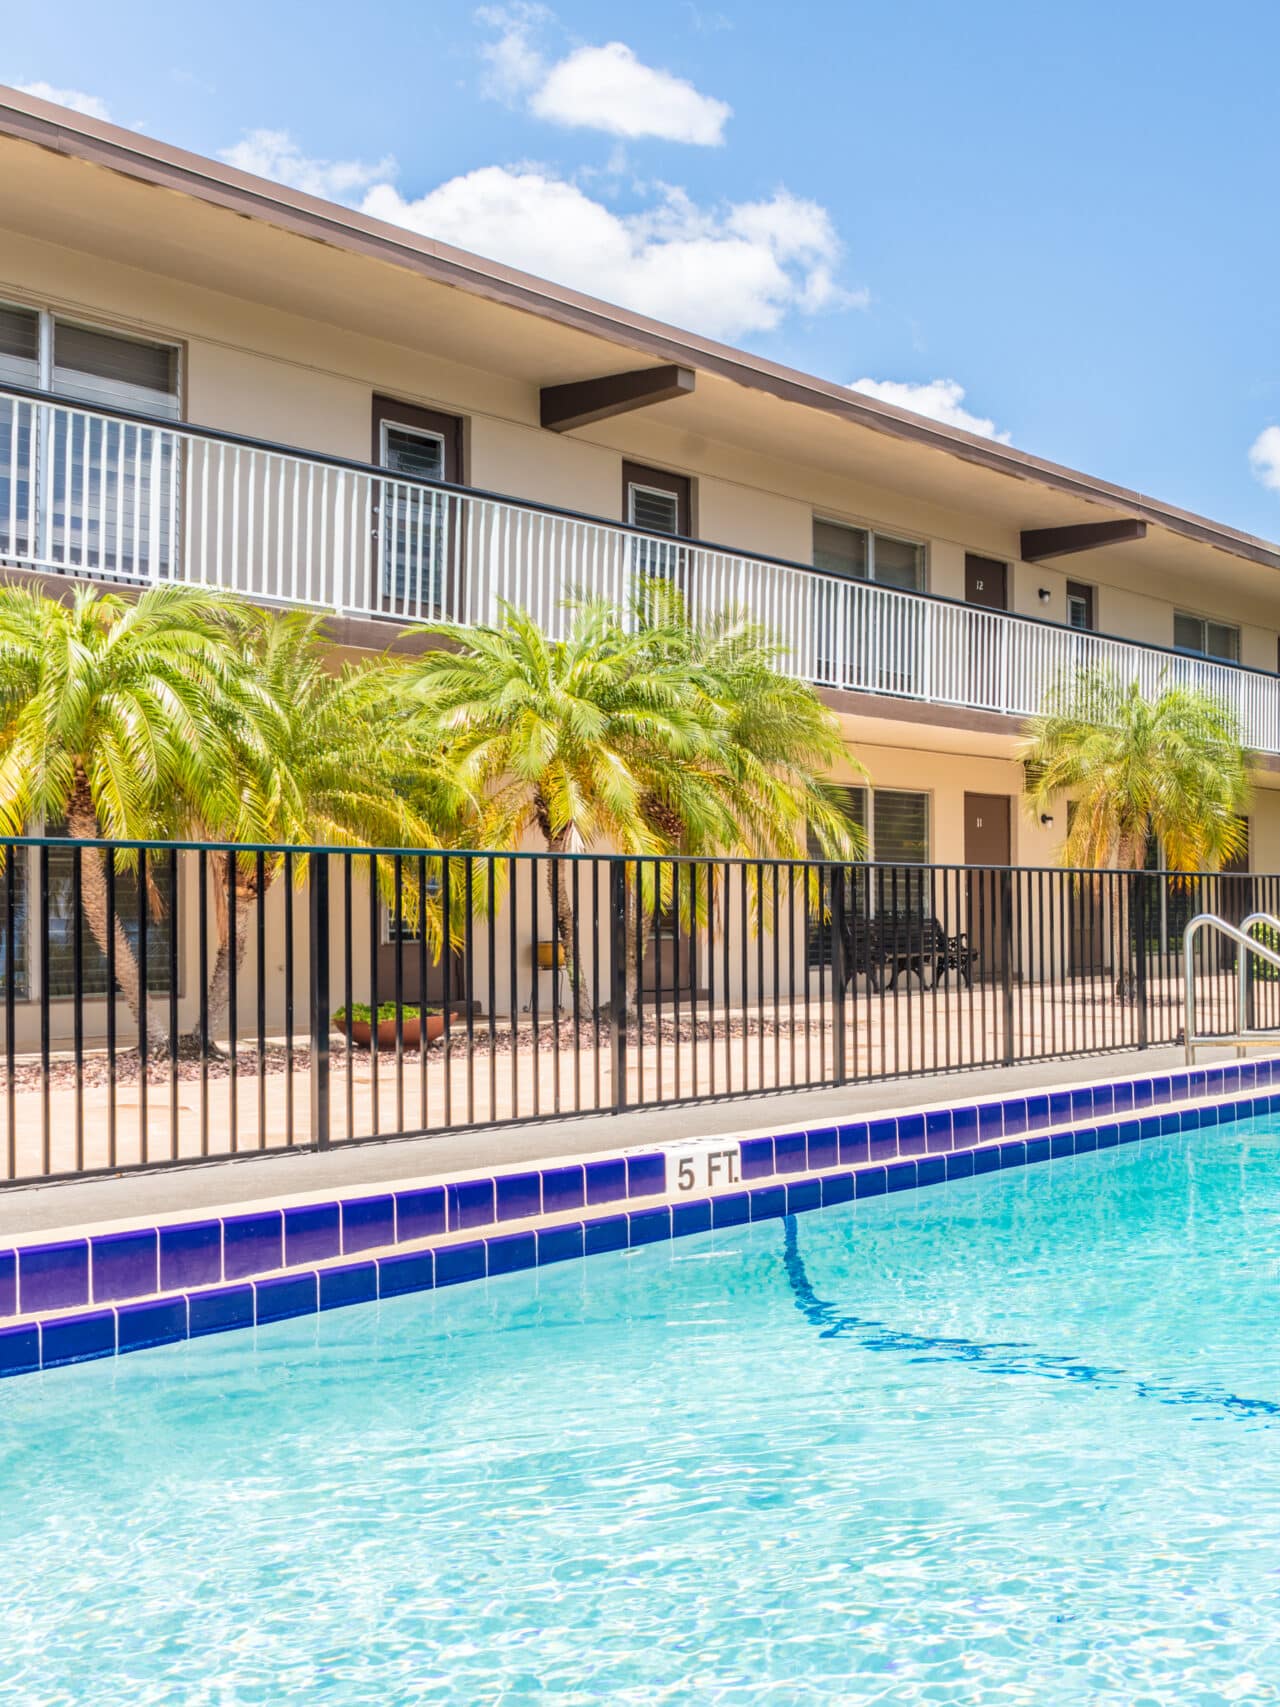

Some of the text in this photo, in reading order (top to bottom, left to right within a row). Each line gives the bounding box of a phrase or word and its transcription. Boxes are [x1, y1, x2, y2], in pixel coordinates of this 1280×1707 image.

[976, 580, 984, 591] 12
[678, 1149, 739, 1191] 5 FT.
